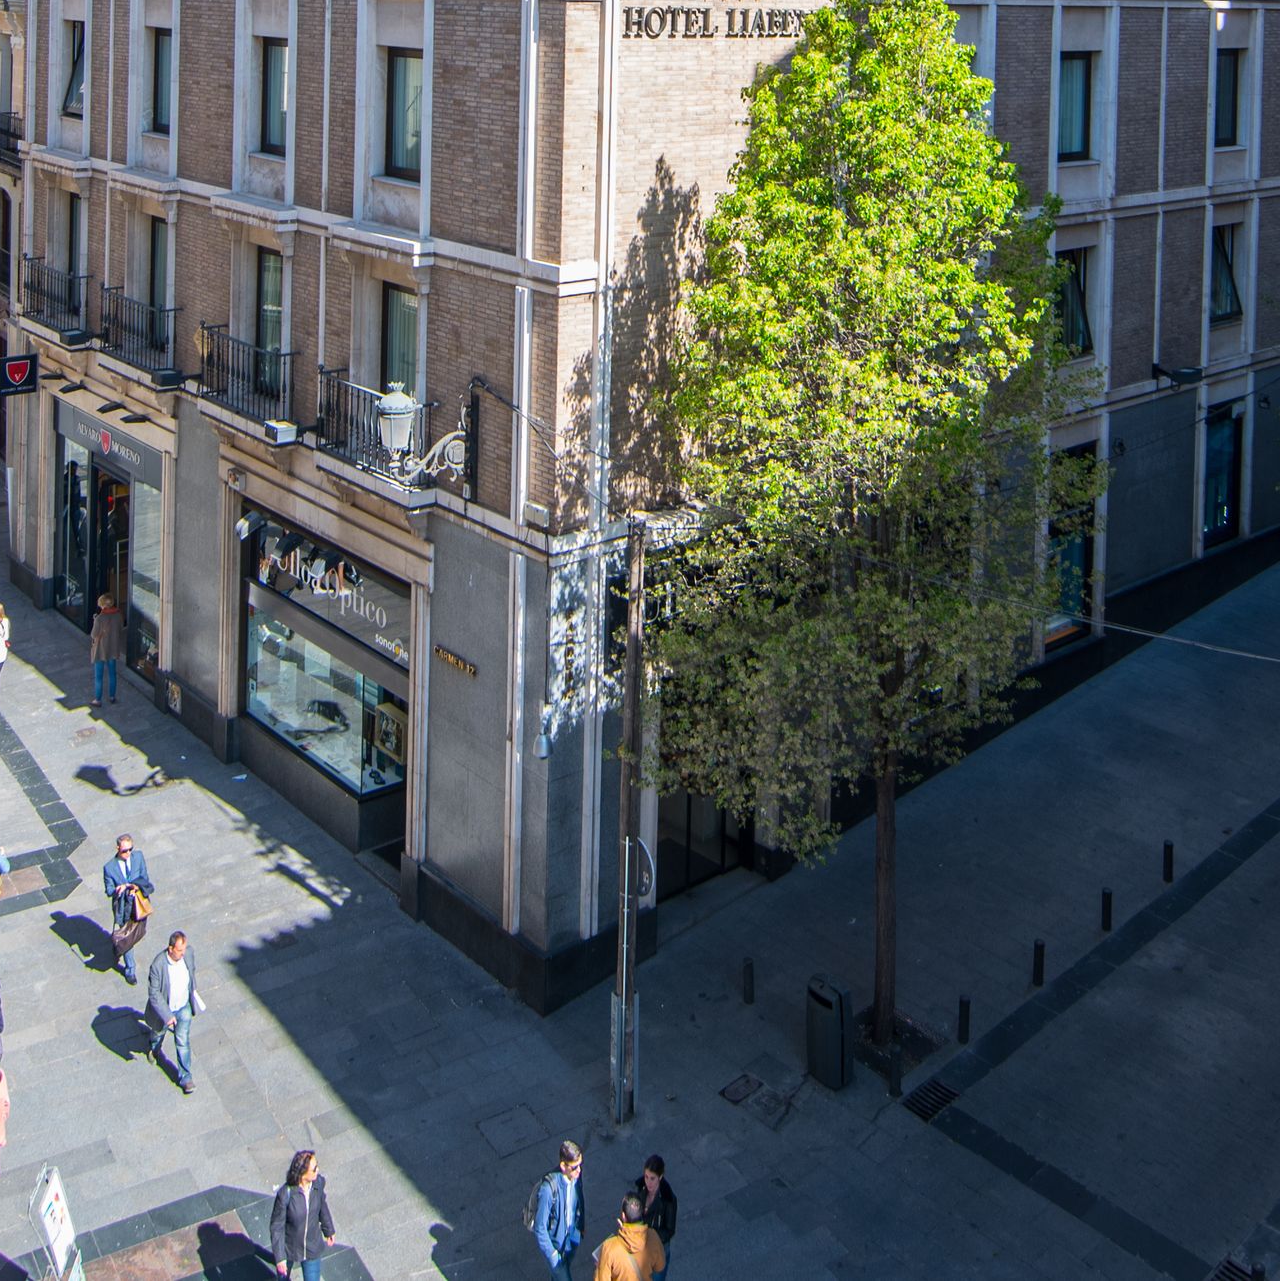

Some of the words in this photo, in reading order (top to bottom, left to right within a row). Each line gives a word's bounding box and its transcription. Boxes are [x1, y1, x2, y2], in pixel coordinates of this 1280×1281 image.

[622, 5, 718, 40] HOTEL
[725, 7, 817, 39] LIABEN
[77, 422, 101, 444] ALVARO
[111, 440, 141, 465] MORENO
[375, 633, 409, 662] sonotone
[433, 645, 465, 670] CARMEN
